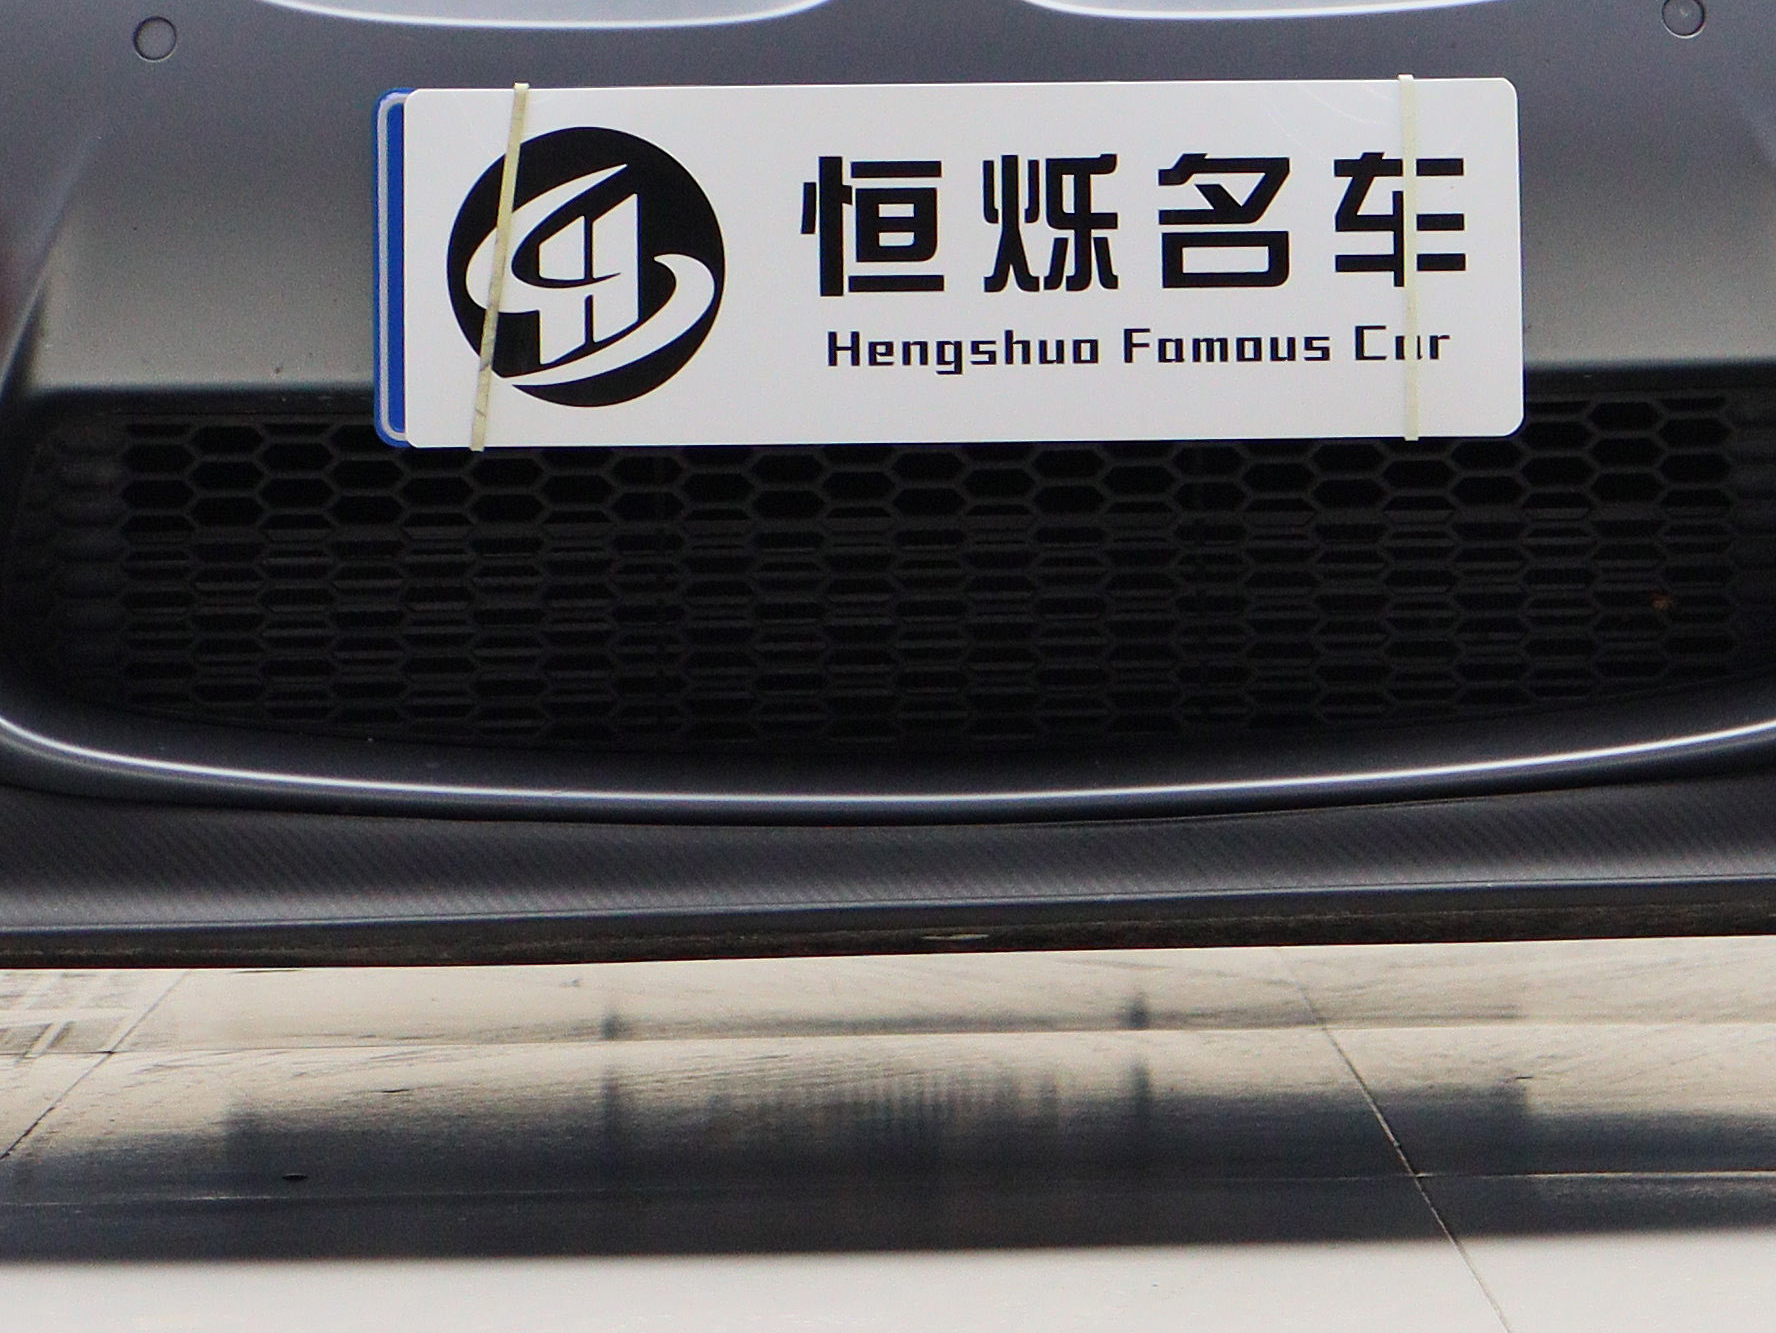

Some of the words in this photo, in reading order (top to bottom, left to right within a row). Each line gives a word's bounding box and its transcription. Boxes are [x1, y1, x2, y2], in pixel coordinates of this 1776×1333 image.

[801, 151, 1466, 297] 恒烁名车
[827, 329, 1099, 376] Hengshuo
[1123, 328, 1331, 364] Famous
